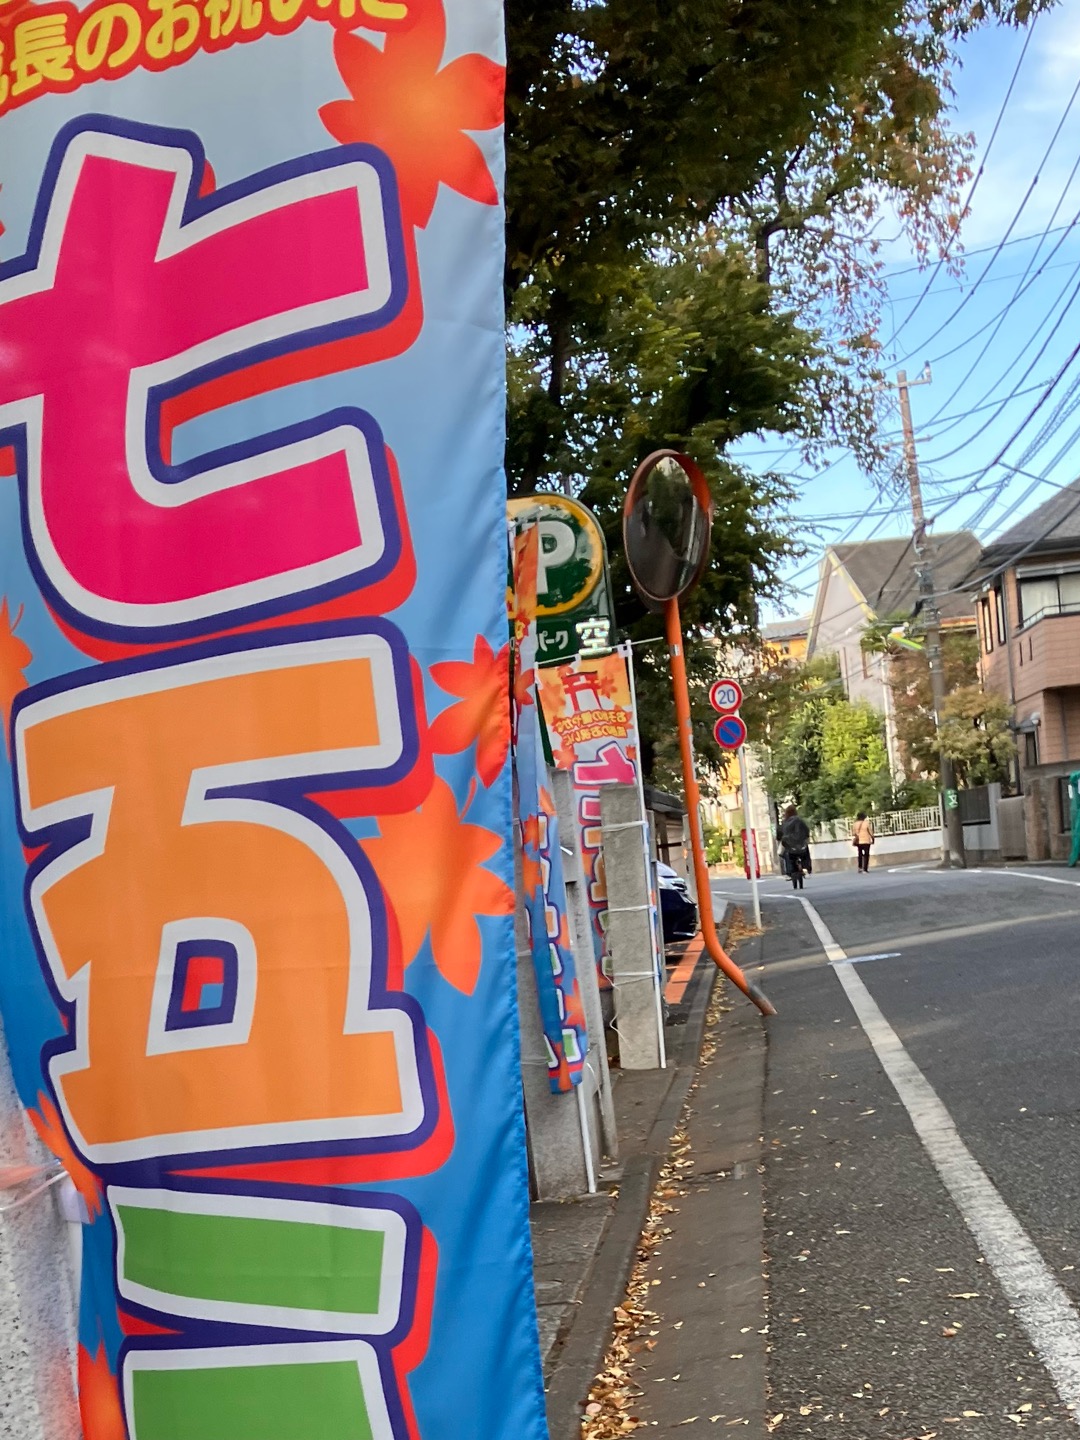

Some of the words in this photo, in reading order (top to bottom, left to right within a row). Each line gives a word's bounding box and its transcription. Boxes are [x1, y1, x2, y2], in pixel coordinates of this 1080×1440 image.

[0, 0, 408, 100] 長のお祝
[522, 520, 575, 594] P
[717, 689, 736, 705] 20
